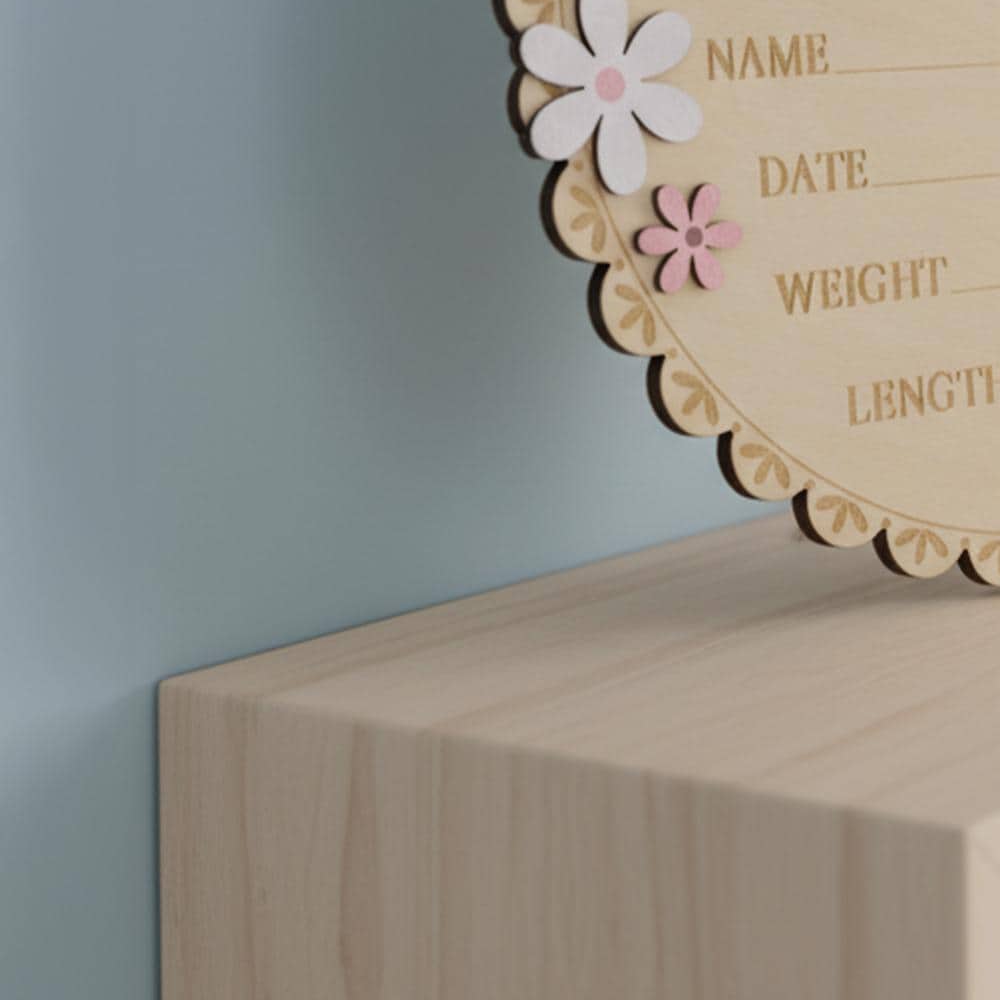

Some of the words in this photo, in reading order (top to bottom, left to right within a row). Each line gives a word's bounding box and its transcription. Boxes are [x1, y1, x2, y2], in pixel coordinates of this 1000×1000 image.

[706, 33, 830, 81] NAME
[758, 148, 869, 198] DATE
[775, 256, 949, 316] WEIGHT
